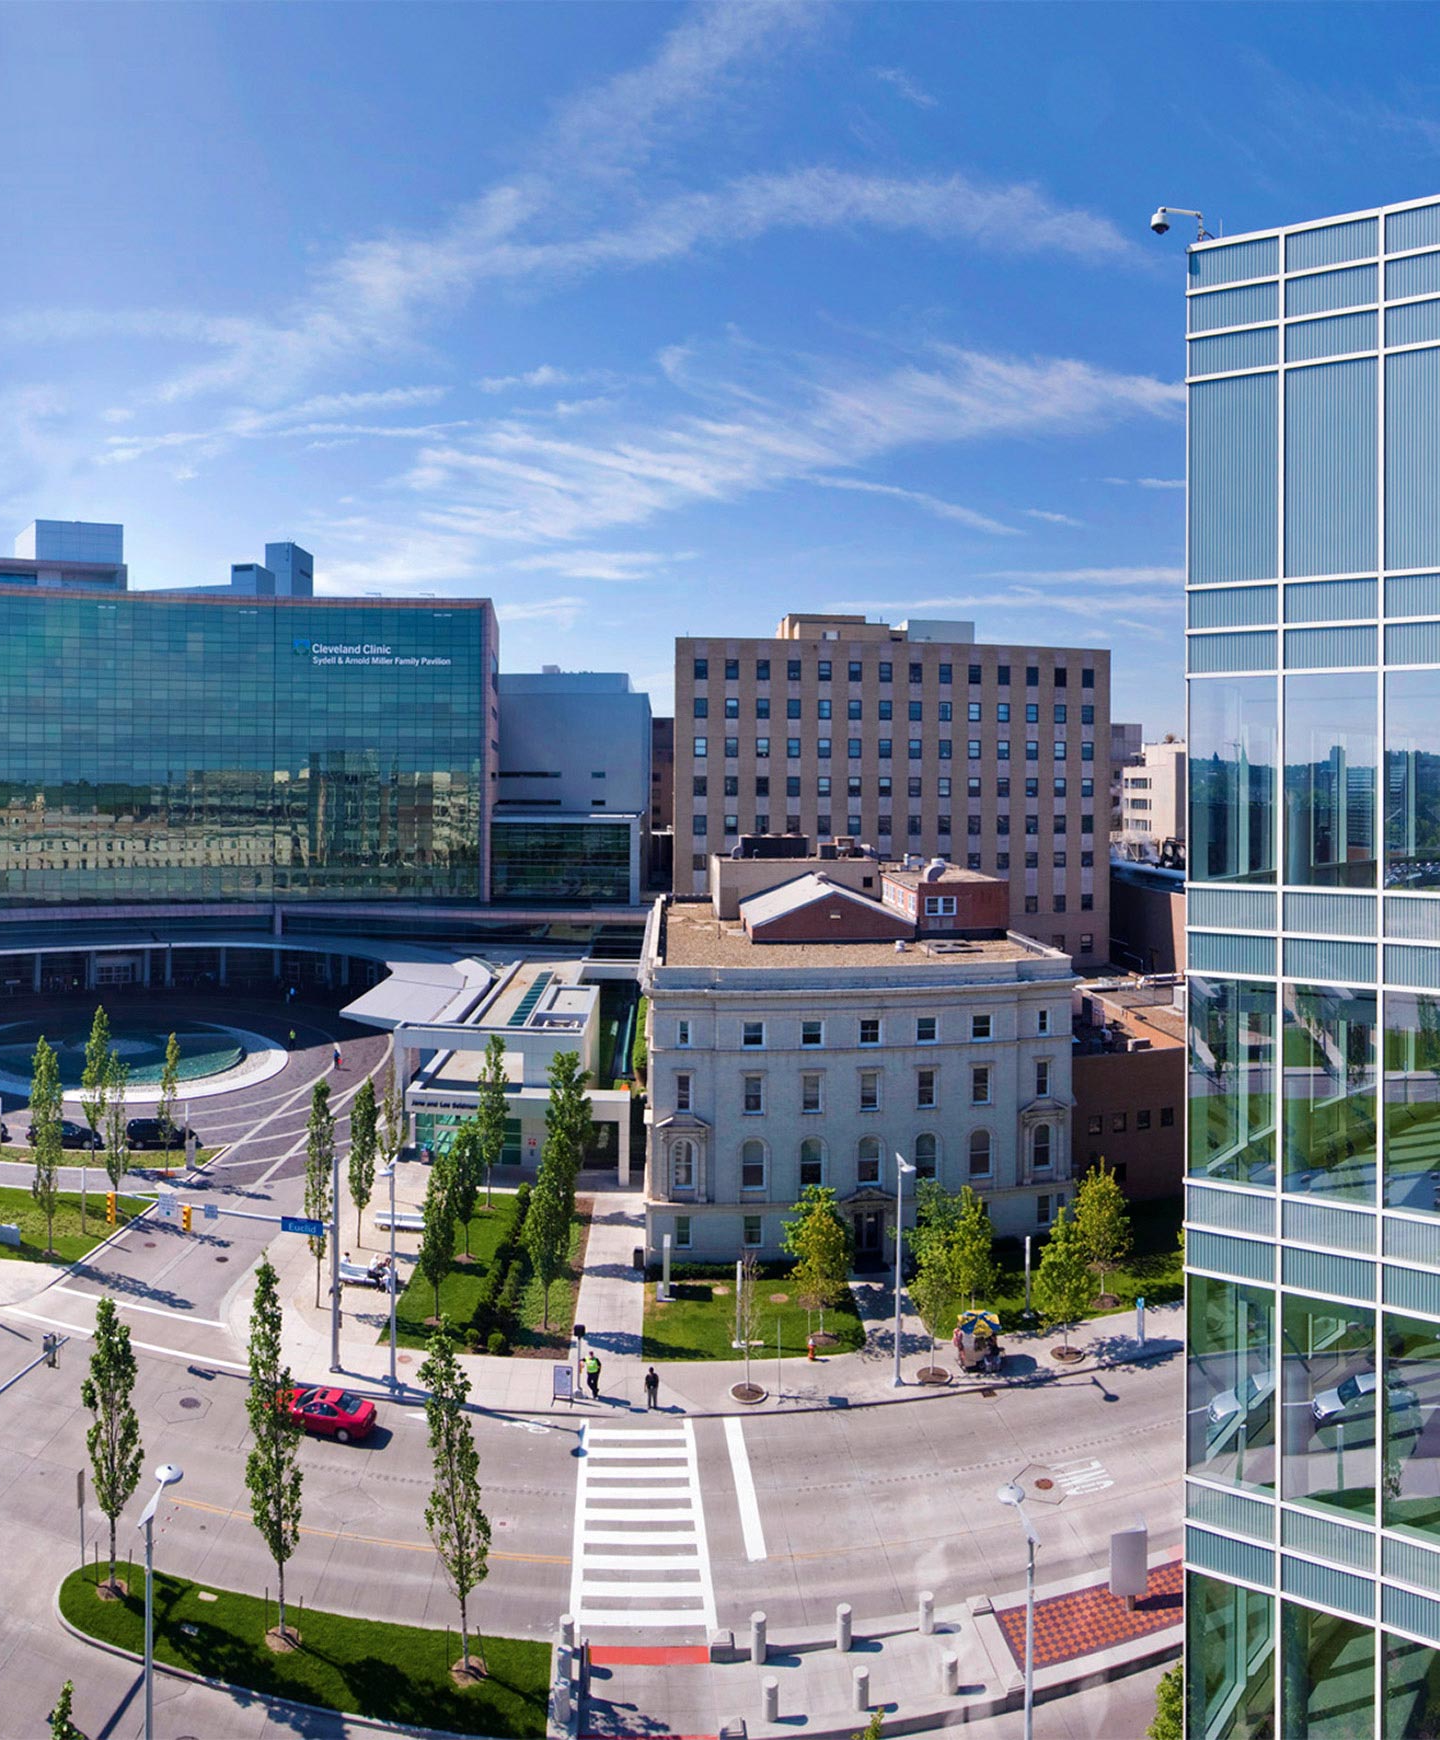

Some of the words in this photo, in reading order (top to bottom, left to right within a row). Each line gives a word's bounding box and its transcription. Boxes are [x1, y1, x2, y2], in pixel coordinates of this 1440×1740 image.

[312, 643, 361, 654] Cleveland
[362, 644, 391, 654] Clinic
[312, 656, 336, 666] Sydell
[337, 656, 343, 665] &
[345, 657, 370, 665] Arnold
[371, 657, 393, 665] Miller
[394, 657, 419, 667] Family
[421, 657, 451, 666] Pavilion
[288, 1223, 316, 1233] Euclid
[1047, 1456, 1115, 1496] ONLY
